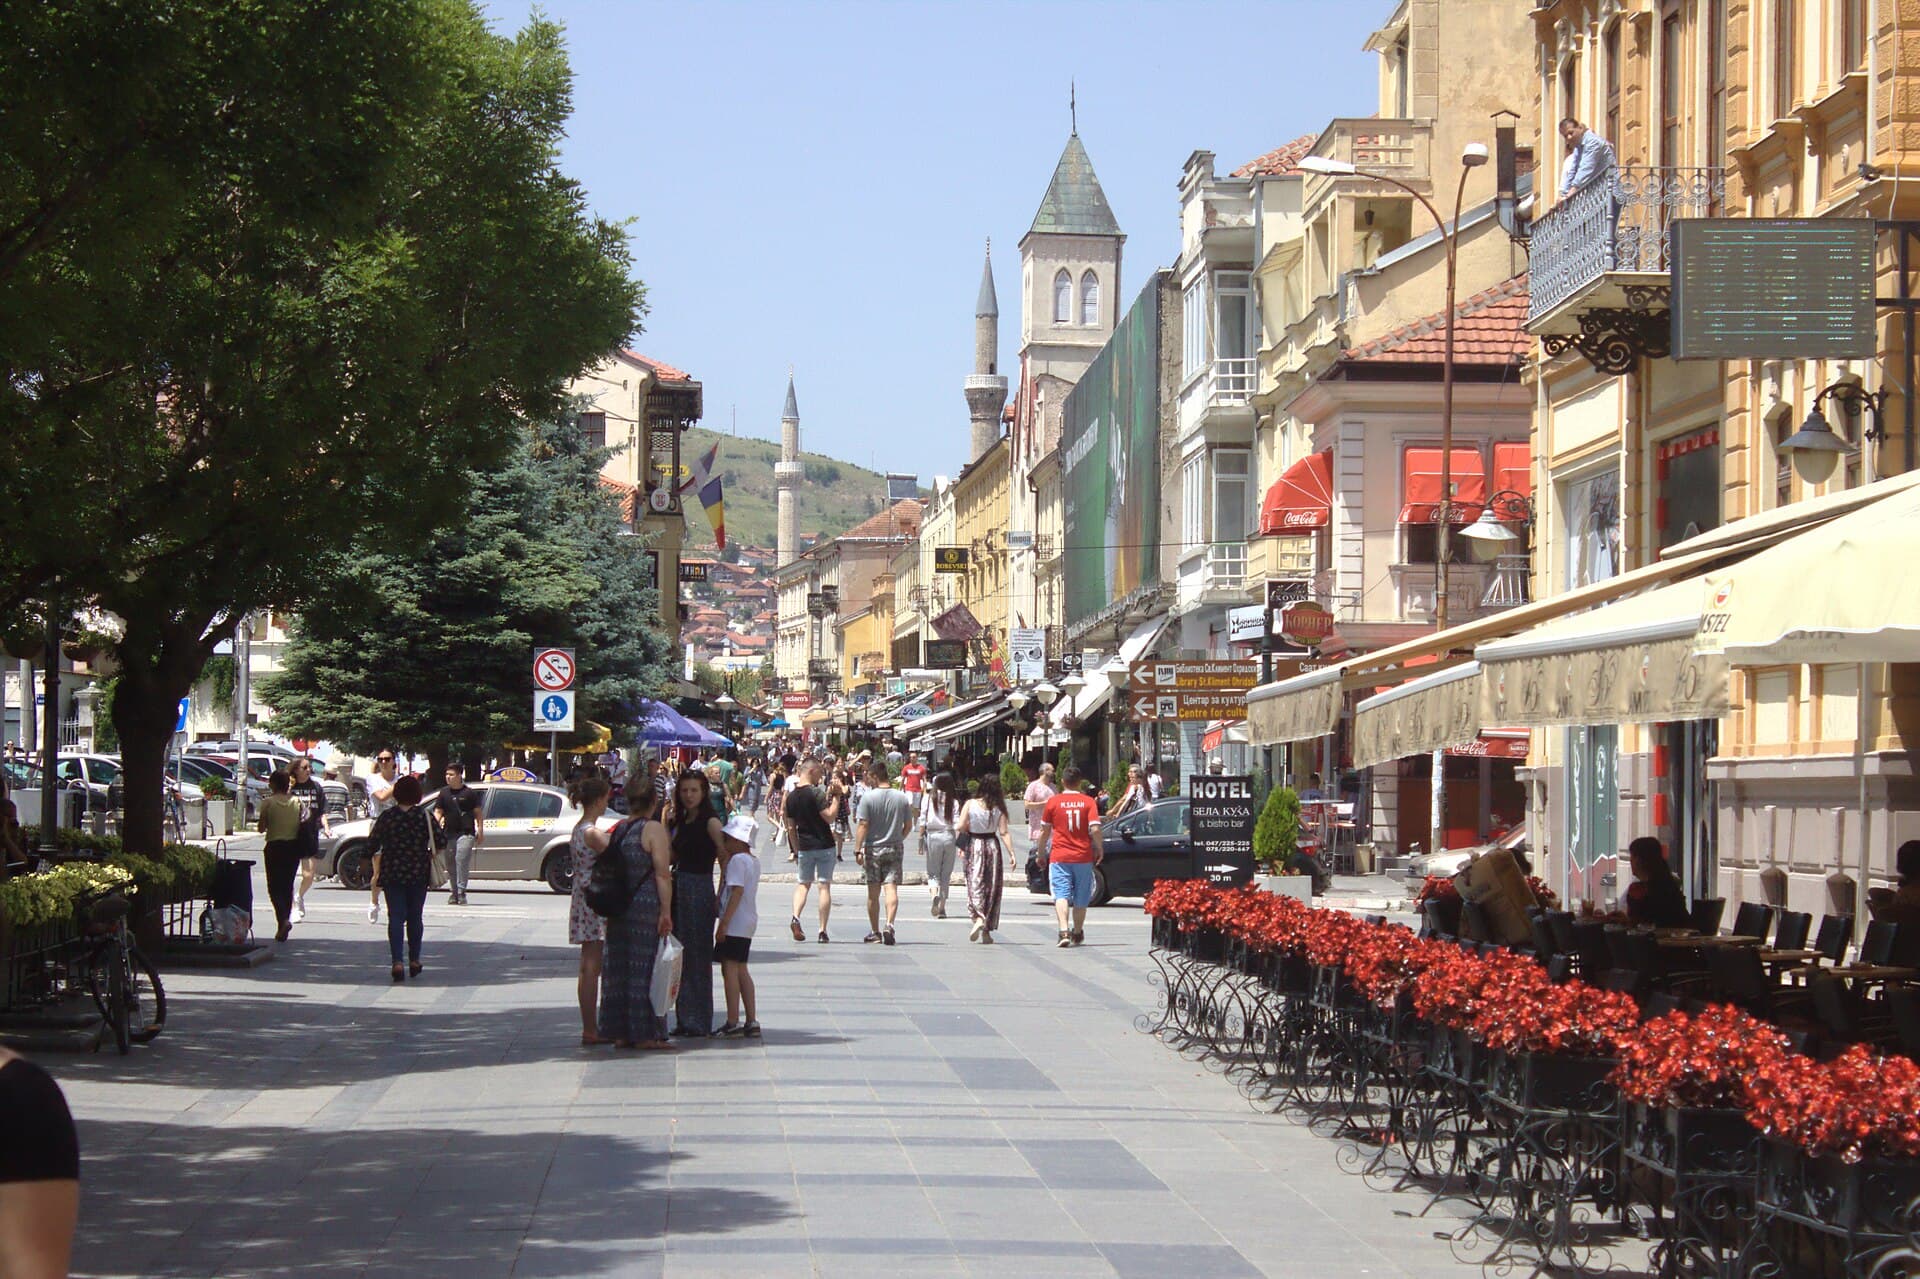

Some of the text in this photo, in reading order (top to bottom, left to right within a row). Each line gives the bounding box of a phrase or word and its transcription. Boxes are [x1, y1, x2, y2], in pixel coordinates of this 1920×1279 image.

[1183, 695, 1209, 707] Центар
[1211, 697, 1219, 705] за
[1179, 707, 1248, 718] Centre for cultu
[1192, 782, 1251, 799] HOTEL
[1193, 807, 1219, 816] БЕЛА
[1066, 809, 1080, 832] 11
[1207, 819, 1229, 828] bistro
[1231, 819, 1244, 828] bar
